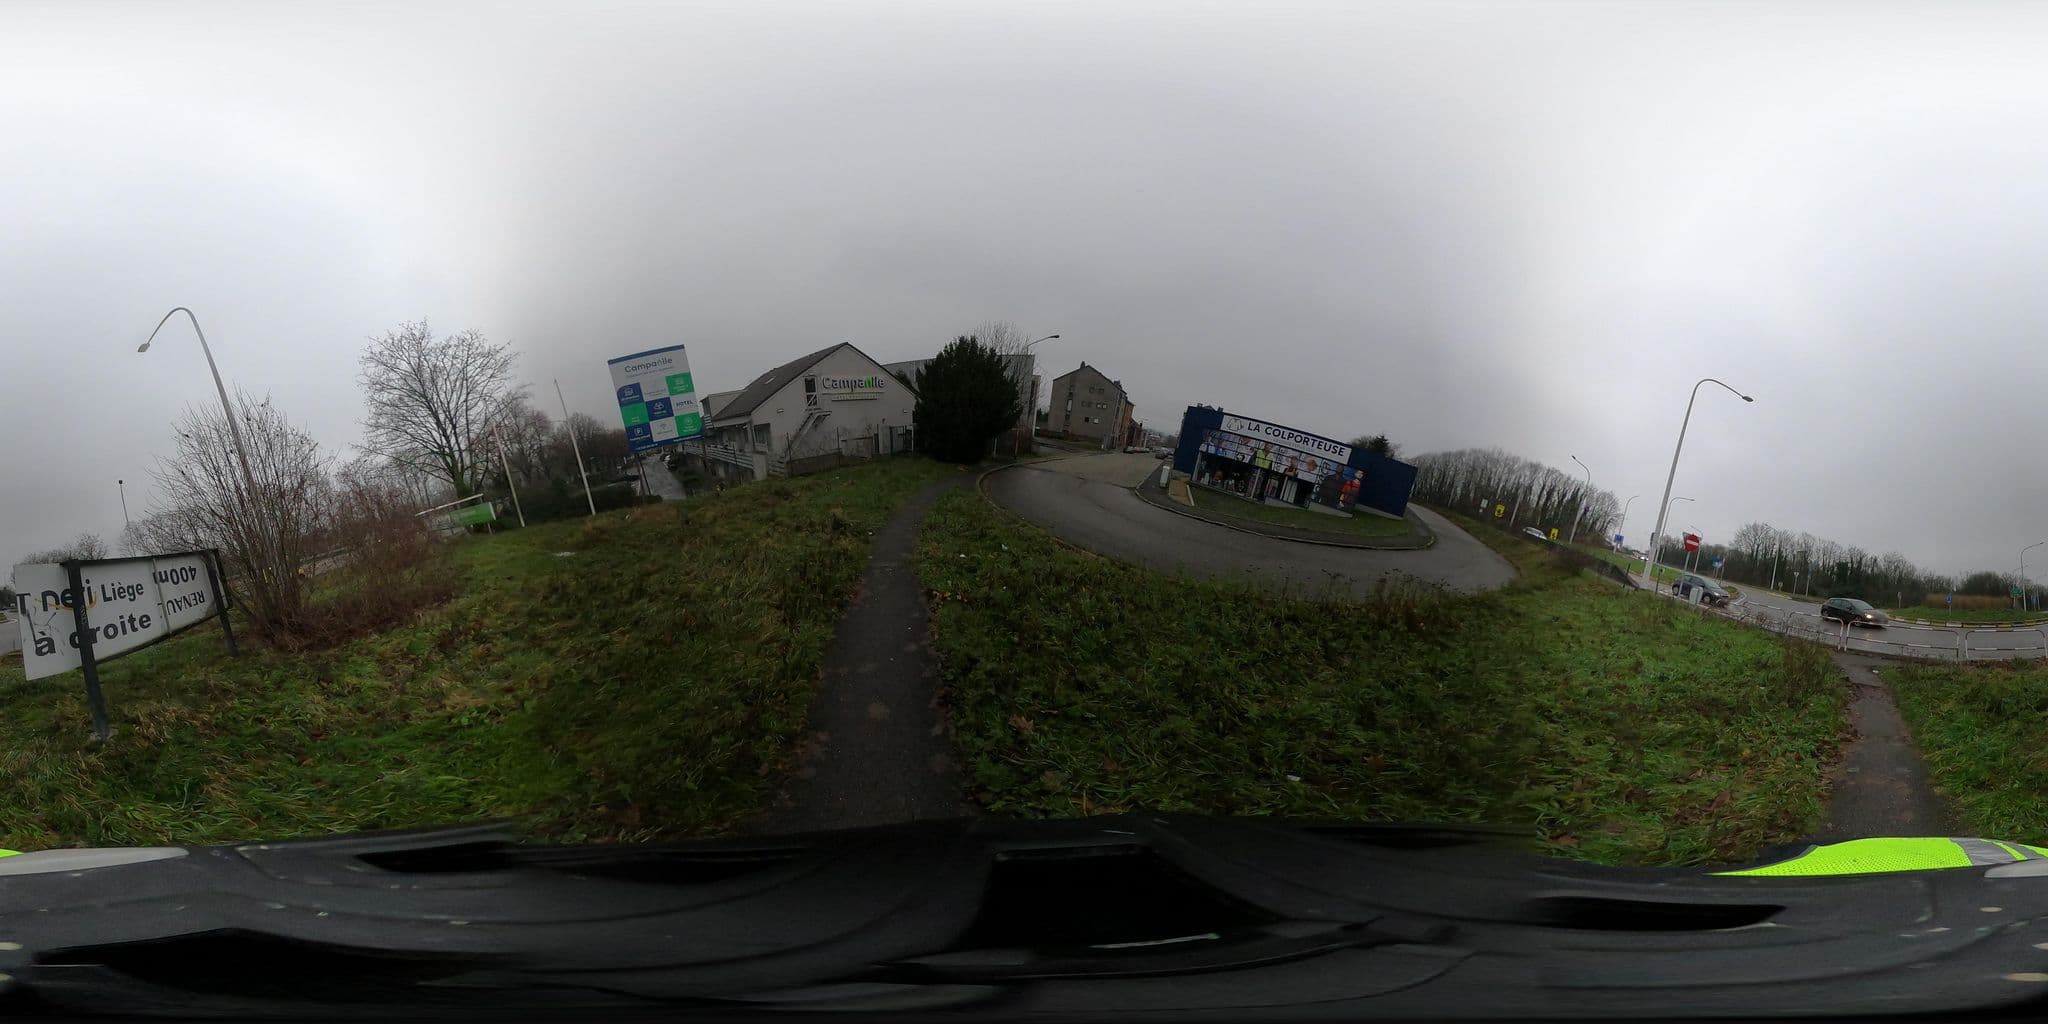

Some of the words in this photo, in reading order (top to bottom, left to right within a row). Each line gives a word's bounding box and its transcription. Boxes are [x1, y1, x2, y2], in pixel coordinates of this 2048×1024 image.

[624, 357, 673, 373] Campanile
[822, 375, 885, 391] Campanile
[1247, 421, 1261, 433] LA
[1264, 426, 1345, 457] COLPORTEUSE
[152, 565, 197, 585] 400m
[100, 581, 145, 603] Liège
[34, 631, 56, 657] à
